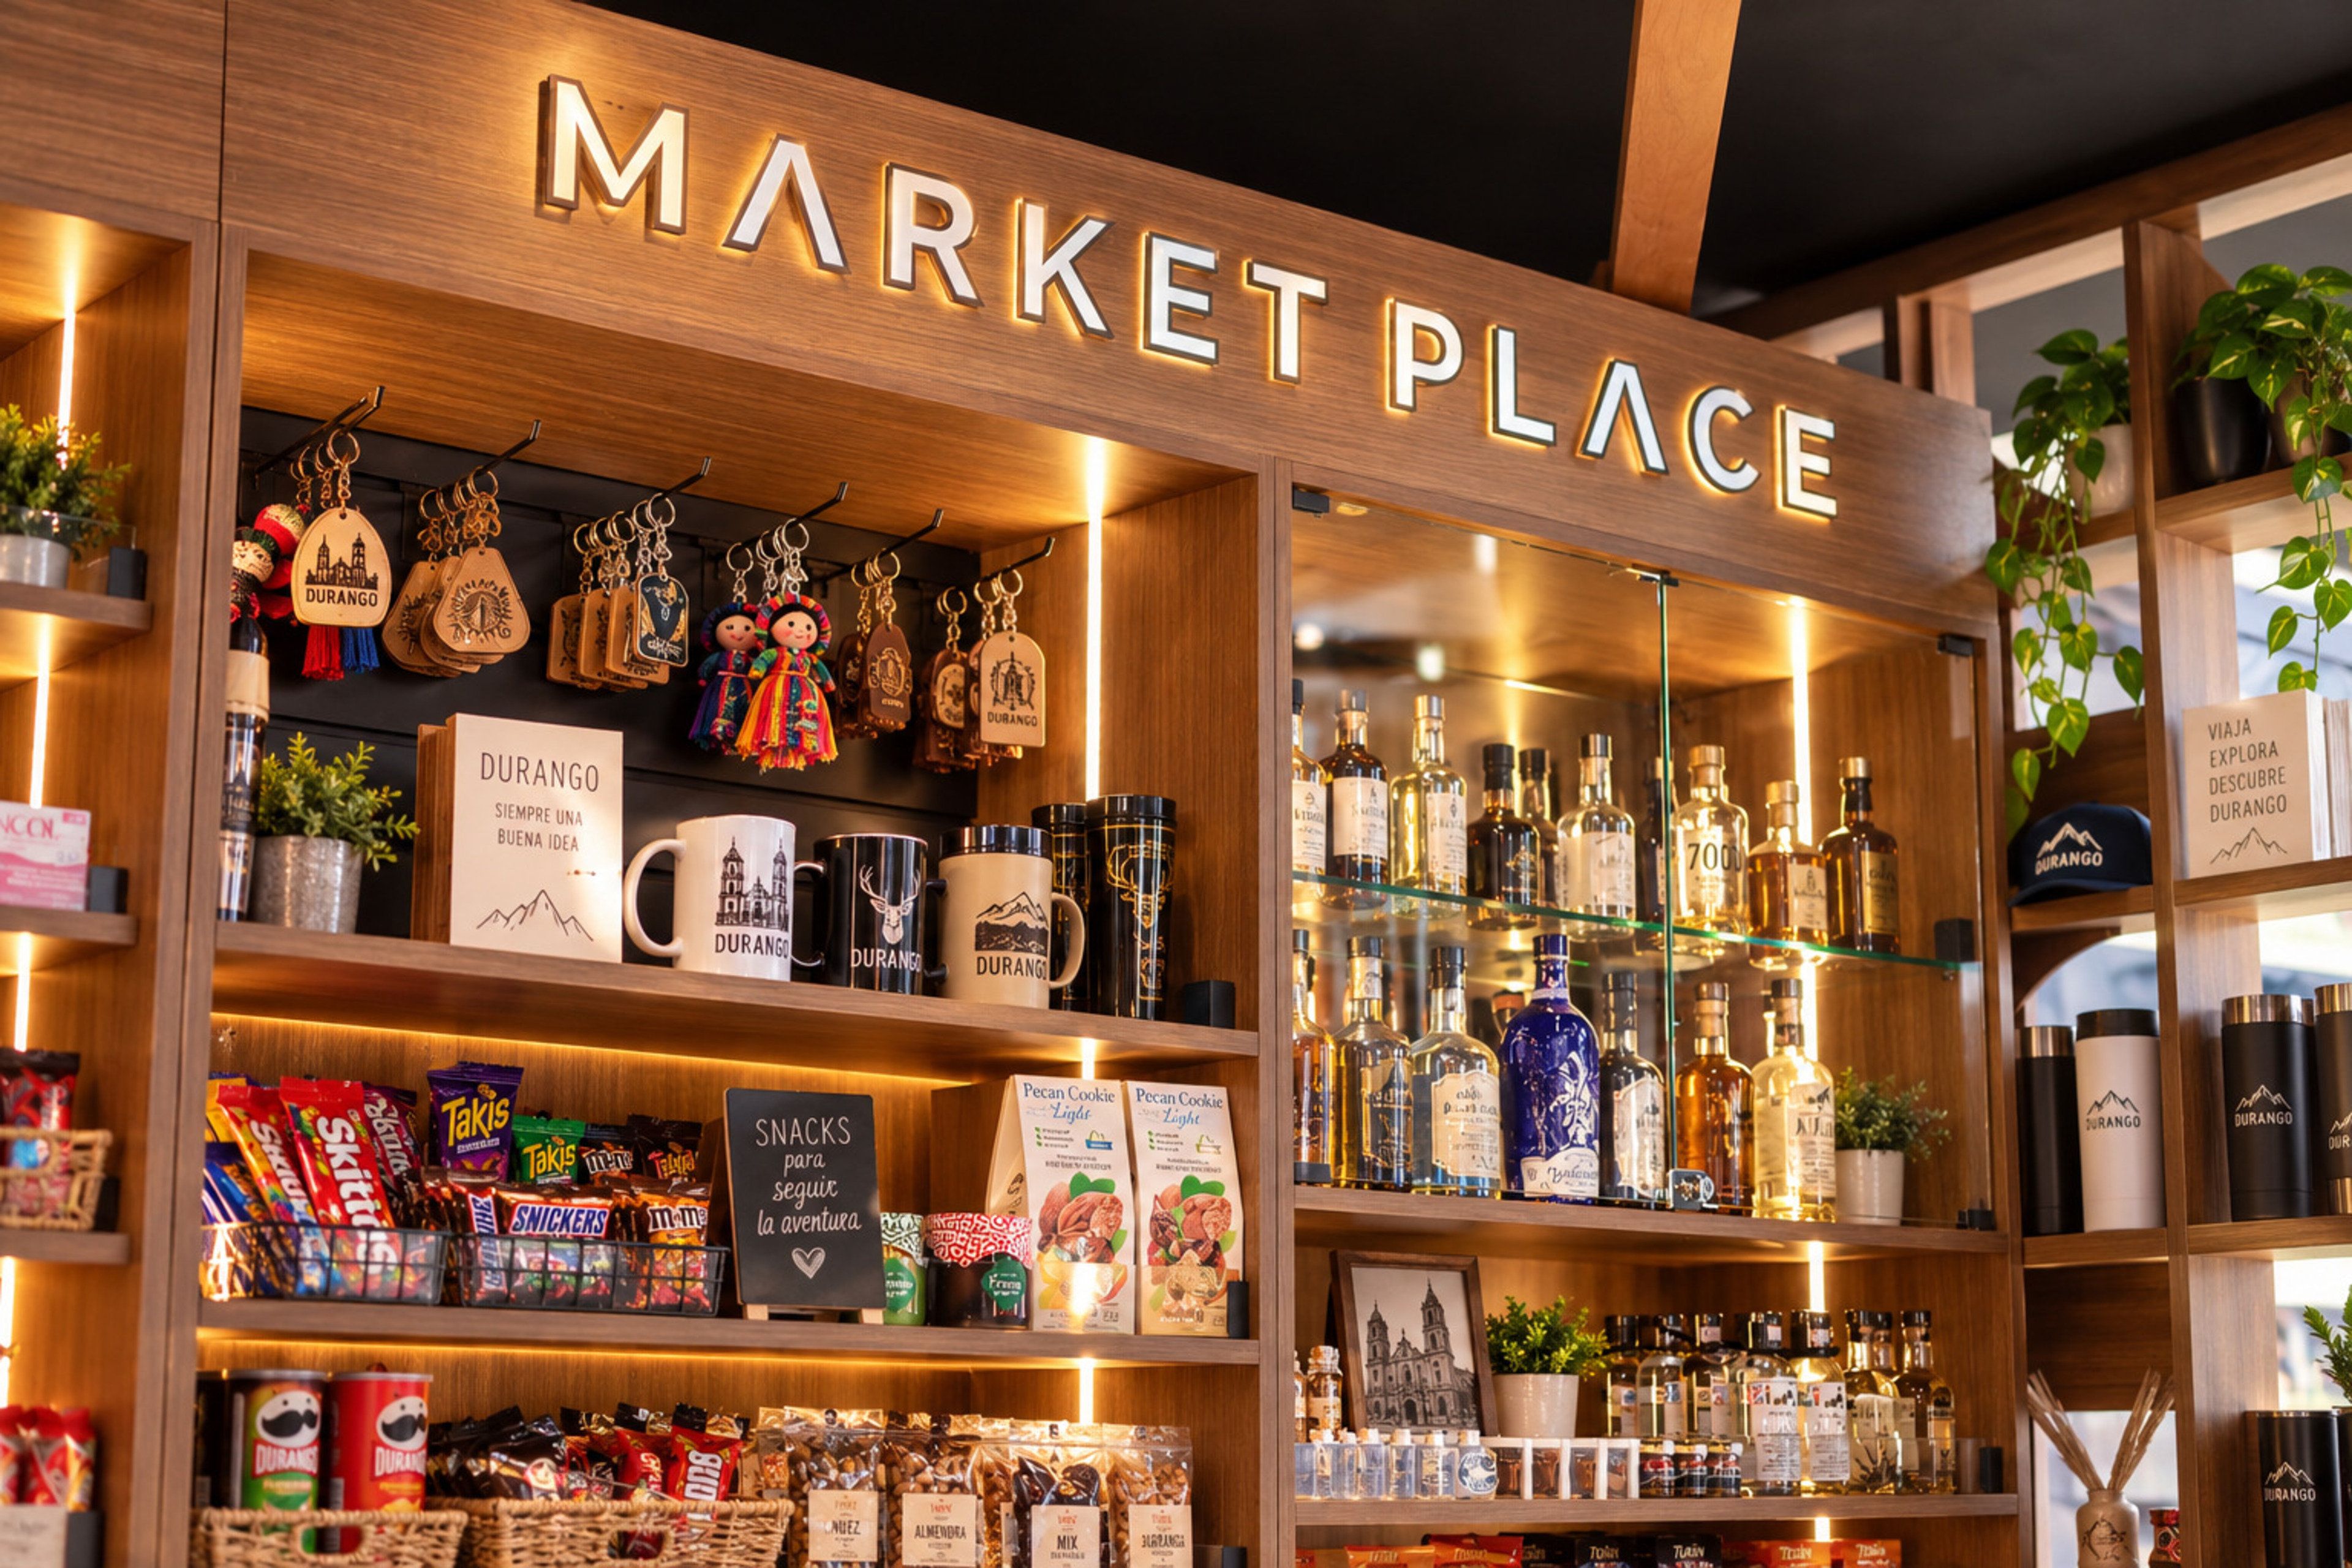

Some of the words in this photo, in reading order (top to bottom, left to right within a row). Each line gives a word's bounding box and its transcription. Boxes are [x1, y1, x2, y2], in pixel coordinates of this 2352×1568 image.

[541, 73, 1328, 385] MARKET
[1387, 298, 1837, 518] PLACE
[306, 588, 378, 607] DURANGO
[987, 711, 1038, 727] DURANGO
[2208, 718, 2252, 741] VIAJA
[2210, 740, 2278, 768] EXPLORA
[480, 752, 600, 793] DURANGO
[2209, 766, 2286, 796] DESCUBRE
[495, 802, 551, 824] SIEMPRE
[556, 809, 583, 826] UNA
[2211, 794, 2287, 823] DURANGO
[497, 828, 543, 849] BUENA
[548, 835, 579, 853] IDEA
[2035, 850, 2103, 875] DURANGO
[715, 933, 790, 959] DURANGO
[851, 948, 922, 973] DURANGO
[1023, 1082, 1065, 1101] Pecan
[1067, 1085, 1116, 1103] Cookie
[1136, 1087, 1176, 1105] Pecan
[1178, 1090, 1223, 1109] Cookie
[441, 1096, 510, 1147] Takis
[756, 1116, 851, 1147] SNACKS
[2234, 1111, 2293, 1128] DURANGO
[522, 1144, 576, 1180] Takis
[783, 1152, 826, 1178] para
[772, 1175, 838, 1210] seguir
[513, 1203, 609, 1236] SNICKERS
[757, 1208, 775, 1236] la
[780, 1206, 862, 1235] aventura
[1057, 1535, 1079, 1550] MIX
